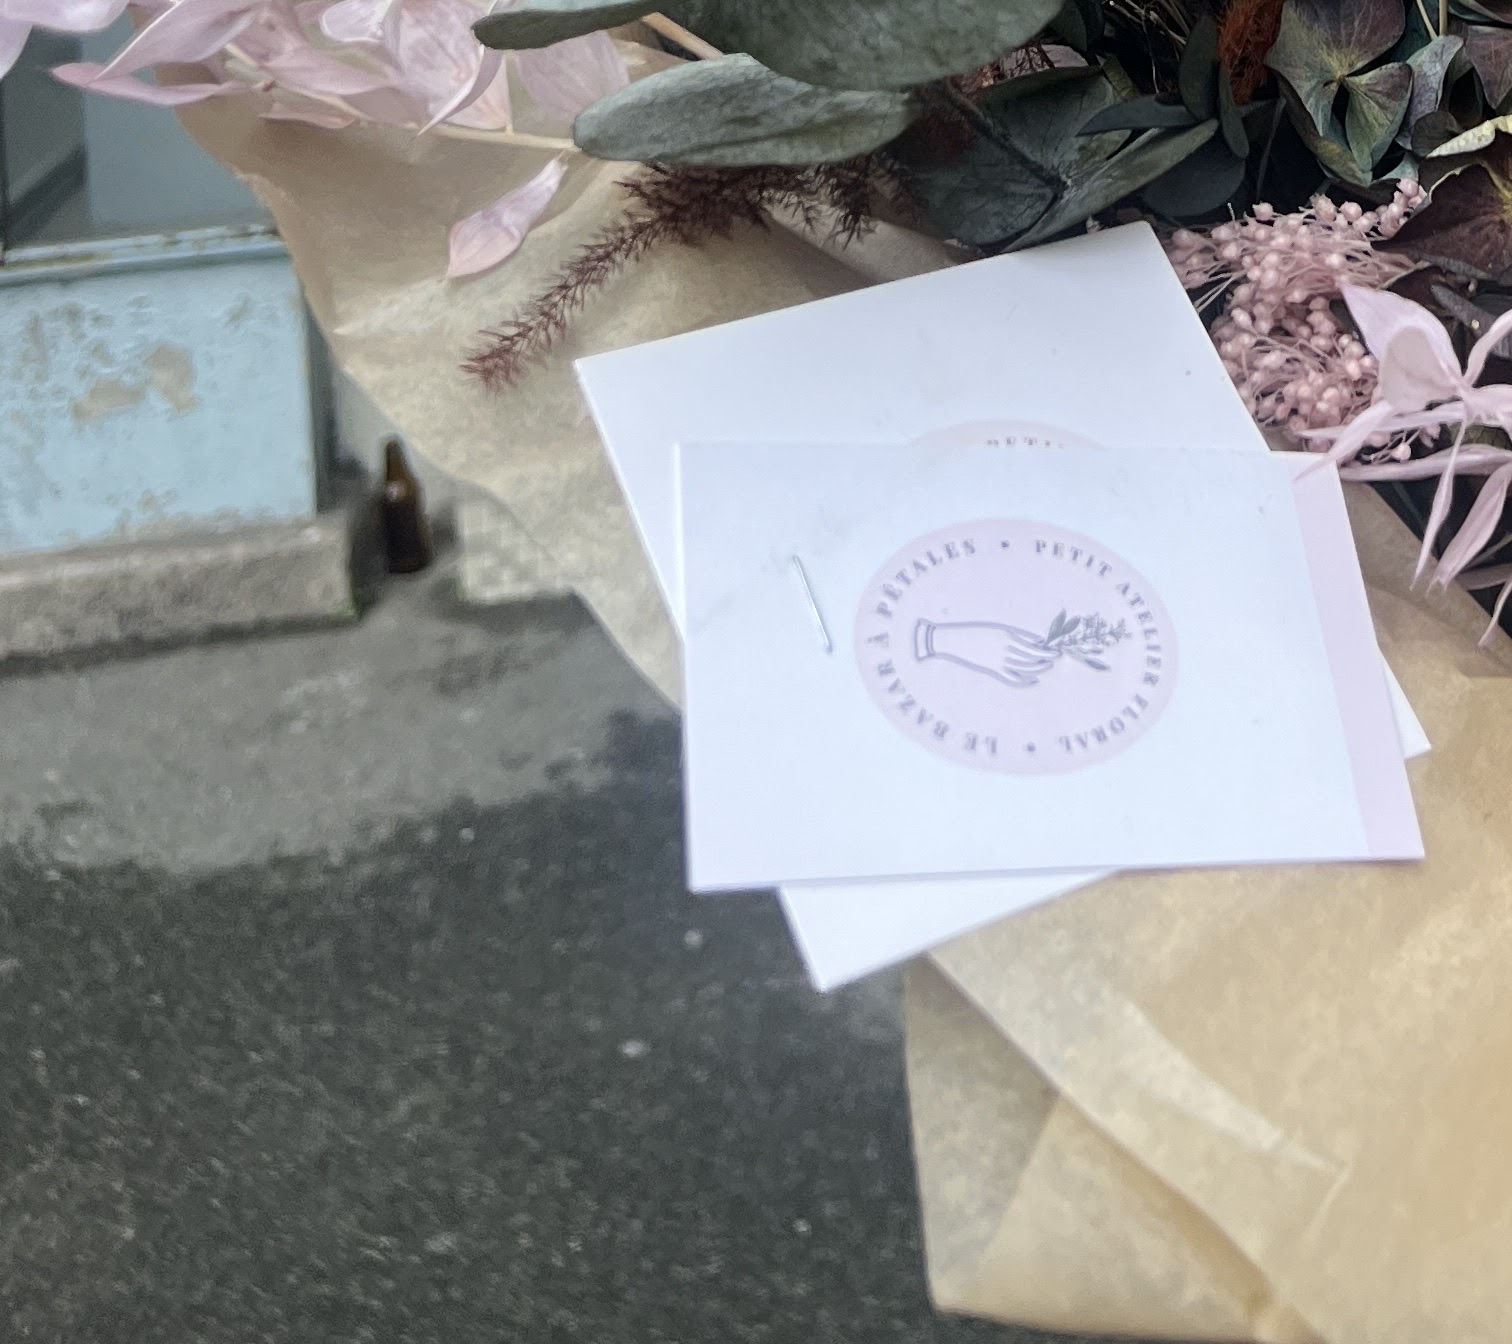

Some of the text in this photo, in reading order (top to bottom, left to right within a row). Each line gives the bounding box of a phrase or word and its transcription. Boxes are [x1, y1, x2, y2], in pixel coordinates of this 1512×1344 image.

[876, 538, 975, 618] PÉTALES
[1034, 539, 1162, 753] PETIT ATELIER FLORAL
[877, 659, 949, 739] BAZAR
[965, 732, 998, 754] LE
